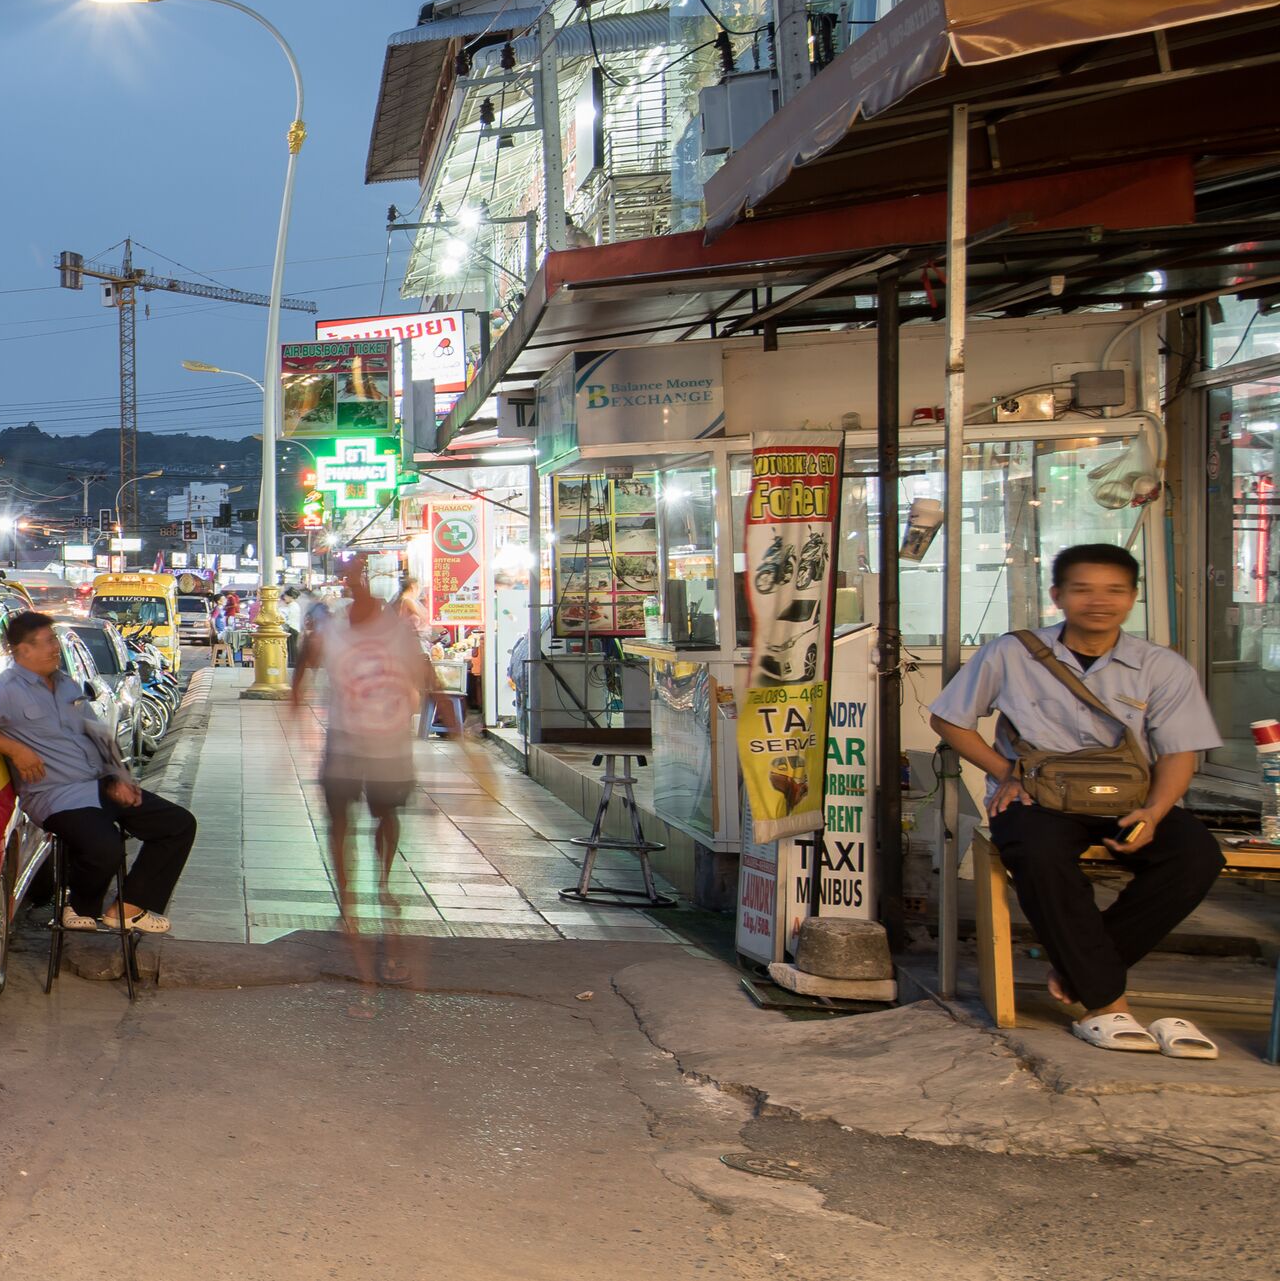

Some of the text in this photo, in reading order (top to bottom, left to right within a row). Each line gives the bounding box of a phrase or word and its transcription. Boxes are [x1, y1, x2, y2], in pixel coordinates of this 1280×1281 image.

[353, 342, 389, 355] TICKET
[611, 378, 714, 393] Balance Money
[611, 390, 714, 408] EXCHANGE
[829, 701, 867, 728] NDRY
[826, 736, 867, 766] AR
[827, 805, 864, 833] RENT
[794, 839, 865, 873] TAXI
[742, 871, 775, 916] LAUNDRY
[796, 876, 863, 907] MNIBUS
